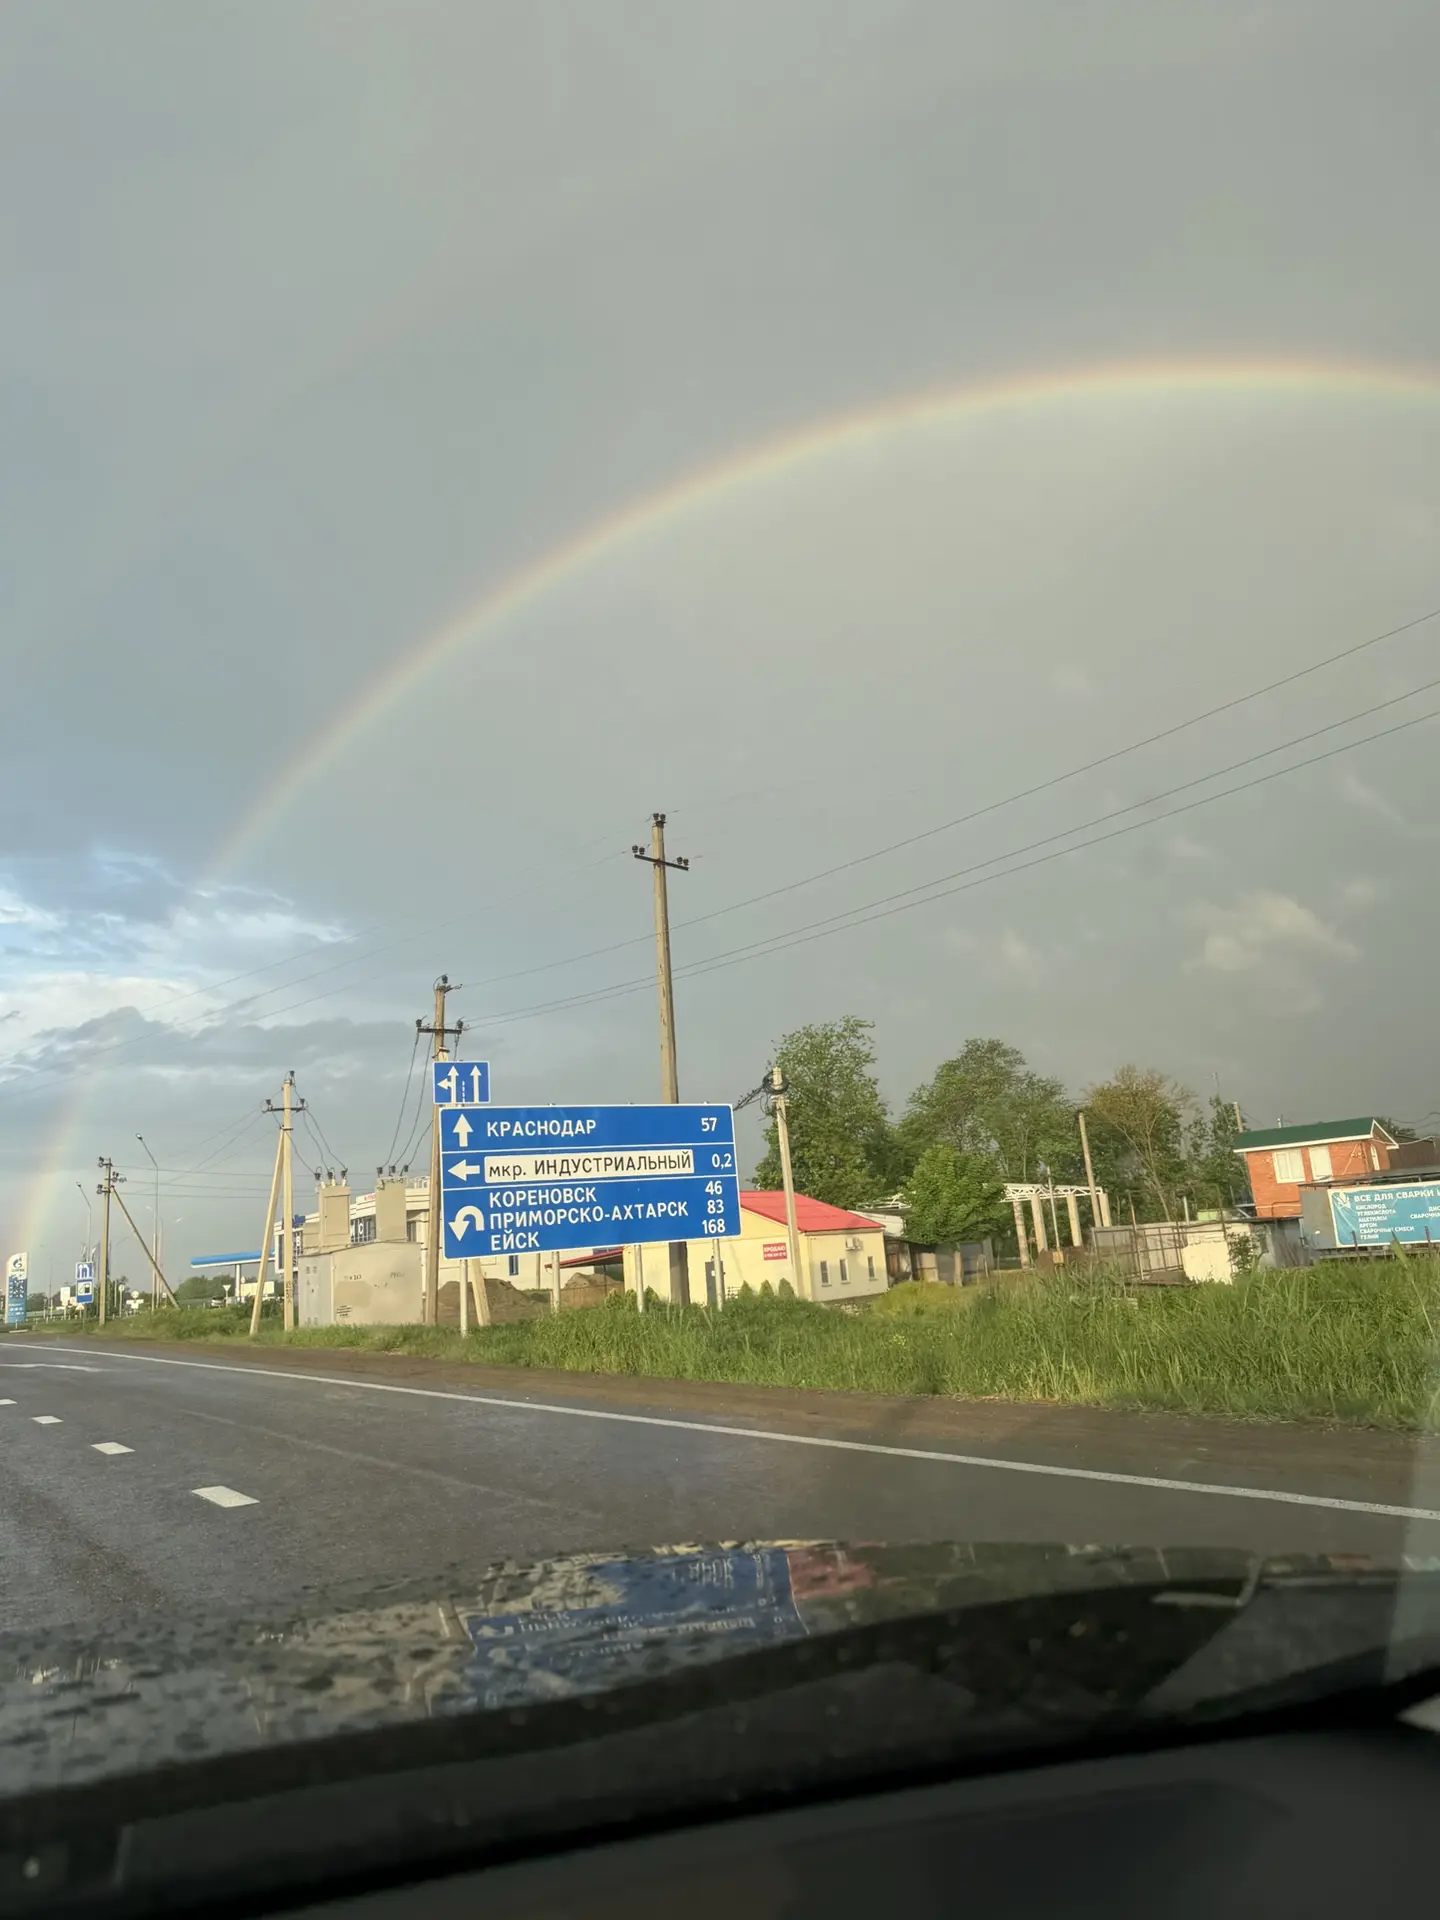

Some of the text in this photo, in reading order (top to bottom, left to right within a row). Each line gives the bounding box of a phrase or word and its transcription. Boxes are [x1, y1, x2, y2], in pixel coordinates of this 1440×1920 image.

[486, 1119, 596, 1137] КРАСНОДАР
[701, 1117, 718, 1132] 57
[489, 1151, 692, 1180] мкр. ИНДУСТРИАЛЬНЫЙ
[711, 1153, 732, 1171] 0,2
[705, 1180, 723, 1195] 46
[1354, 1194, 1371, 1202] ВСЕ
[1374, 1193, 1393, 1201] ДЛЯ
[1396, 1189, 1434, 1199] СВАРКИ
[489, 1187, 597, 1208] КОРЕНОВСК
[707, 1199, 725, 1214] 83
[490, 1201, 689, 1230] ПРИМОРСКО-АХТАРСК
[702, 1219, 726, 1234] 168
[491, 1229, 540, 1251] ЕЙСК
